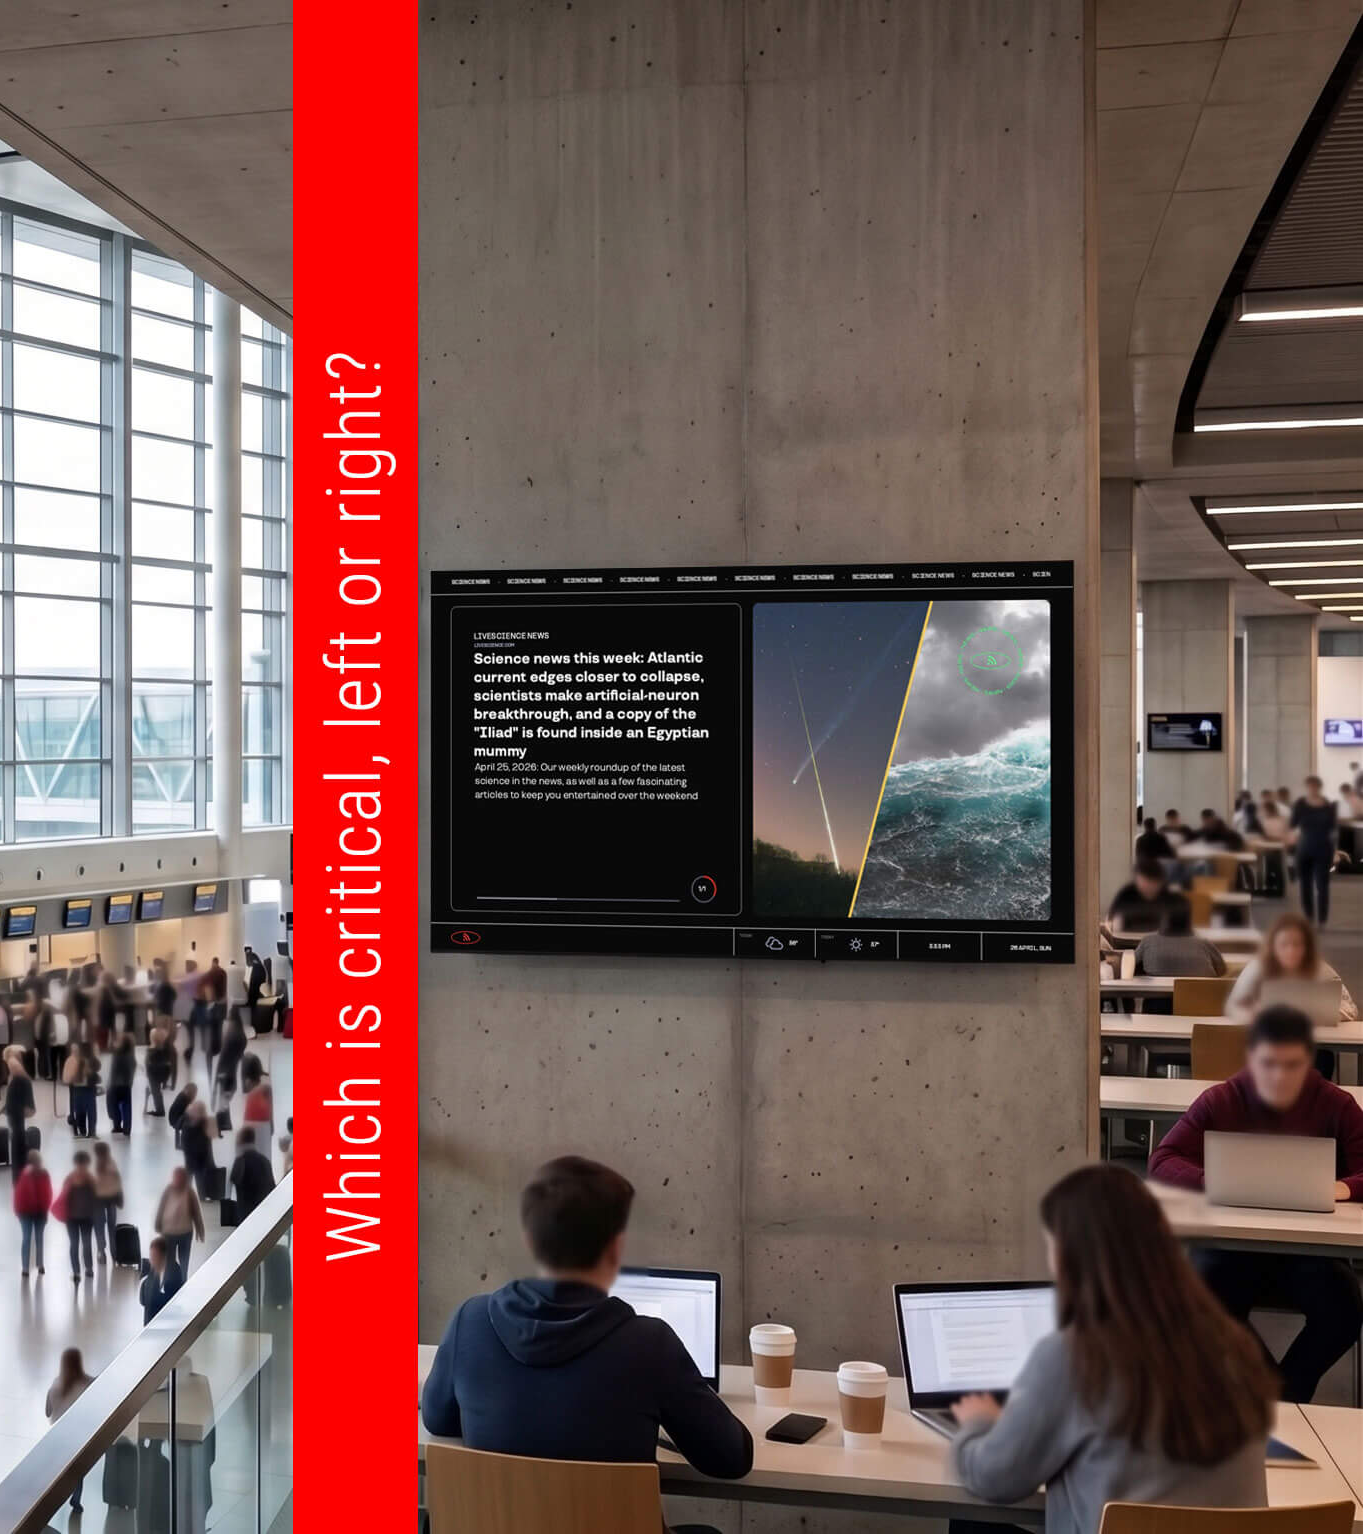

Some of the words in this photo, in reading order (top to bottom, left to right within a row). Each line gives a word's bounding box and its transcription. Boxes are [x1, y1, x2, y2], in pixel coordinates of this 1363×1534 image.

[474, 653, 530, 664] Science
[534, 656, 570, 664] news
[574, 652, 599, 663] this
[603, 652, 644, 663] week:
[647, 652, 703, 663] Atlantic
[474, 673, 526, 682] current
[530, 671, 572, 685] edges
[576, 671, 619, 682] closer
[622, 672, 636, 682] to
[640, 670, 704, 684] collapse,
[474, 690, 541, 701] scientists
[546, 690, 582, 701] make
[586, 689, 699, 700] artificial-neuron
[474, 708, 572, 722] breakthrough,
[576, 708, 601, 719] and
[606, 711, 614, 719] a
[617, 711, 652, 722] copy
[655, 708, 669, 719] of
[673, 708, 696, 719] the
[474, 727, 518, 738] "Iliad"
[522, 727, 533, 738] is
[537, 727, 577, 738] found
[581, 727, 622, 738] inside
[627, 730, 643, 738] an
[648, 727, 709, 741] Egyptian
[474, 748, 526, 759] mummy
[475, 763, 495, 772] April
[497, 763, 510, 771] 25,
[512, 763, 538, 771] 2026:
[541, 763, 557, 771] Our
[558, 763, 589, 773] weekly
[590, 764, 629, 773] roundup
[631, 763, 640, 771] of
[475, 777, 510, 785] science
[522, 777, 537, 785] the
[619, 777, 635, 785] few
[637, 777, 687, 788] fascinating
[522, 791, 543, 800] keep
[545, 793, 561, 801] you
[657, 792, 698, 800] weekend
